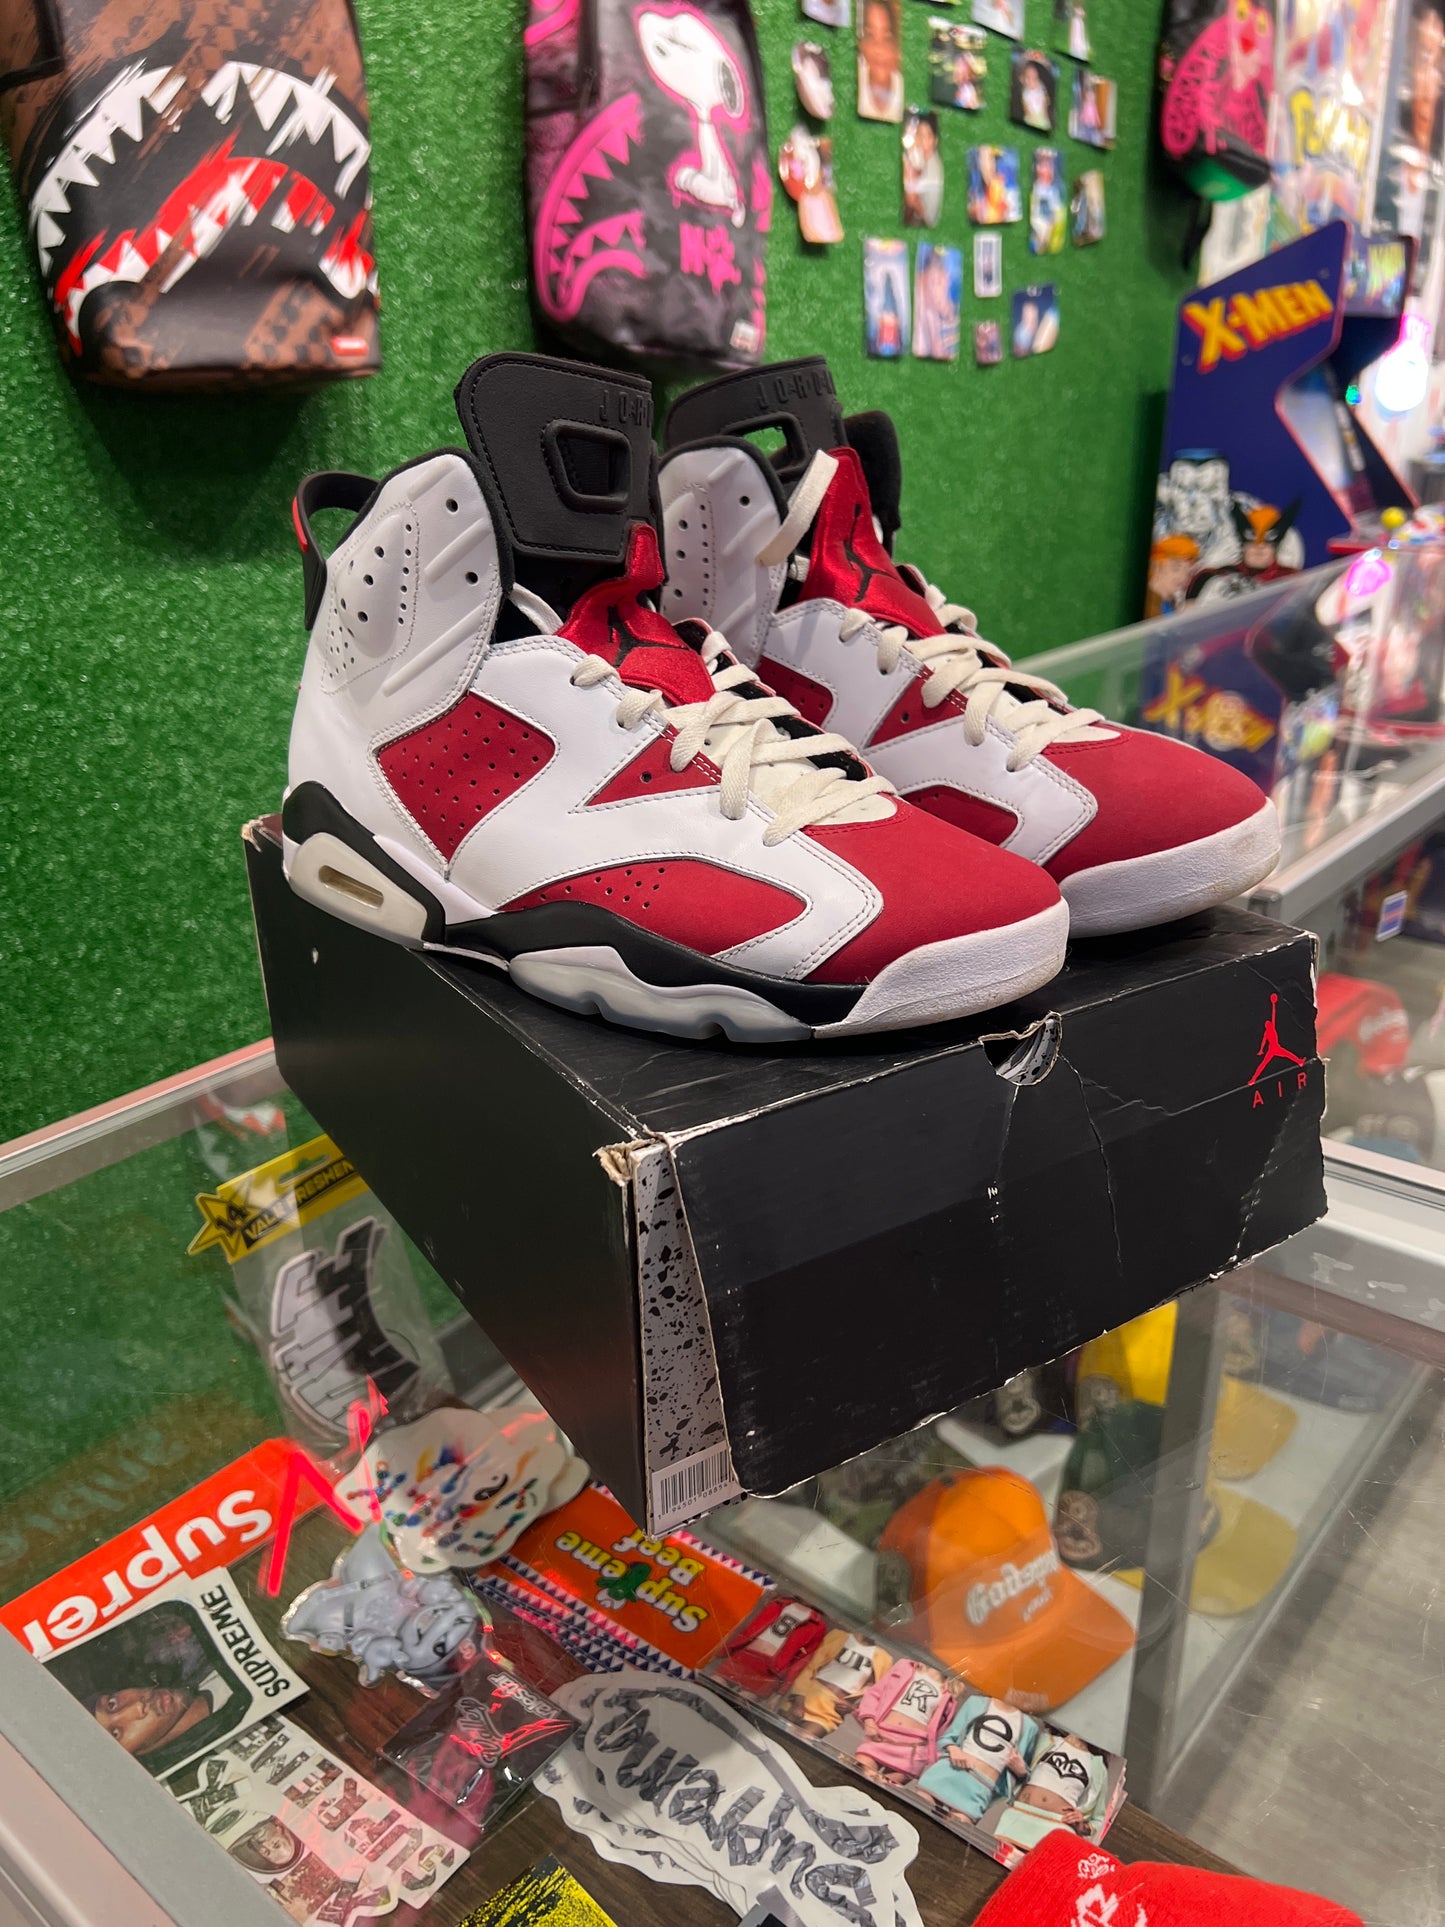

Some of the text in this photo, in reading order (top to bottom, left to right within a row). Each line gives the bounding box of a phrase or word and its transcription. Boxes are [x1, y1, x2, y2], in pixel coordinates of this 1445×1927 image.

[1182, 279, 1334, 374] X-MEN
[1252, 1072, 1307, 1108] AIR
[612, 1528, 706, 1587] Beef
[200, 1584, 291, 1698] SUPREME
[900, 1678, 939, 1714] R
[224, 1713, 456, 1892] SUPREME
